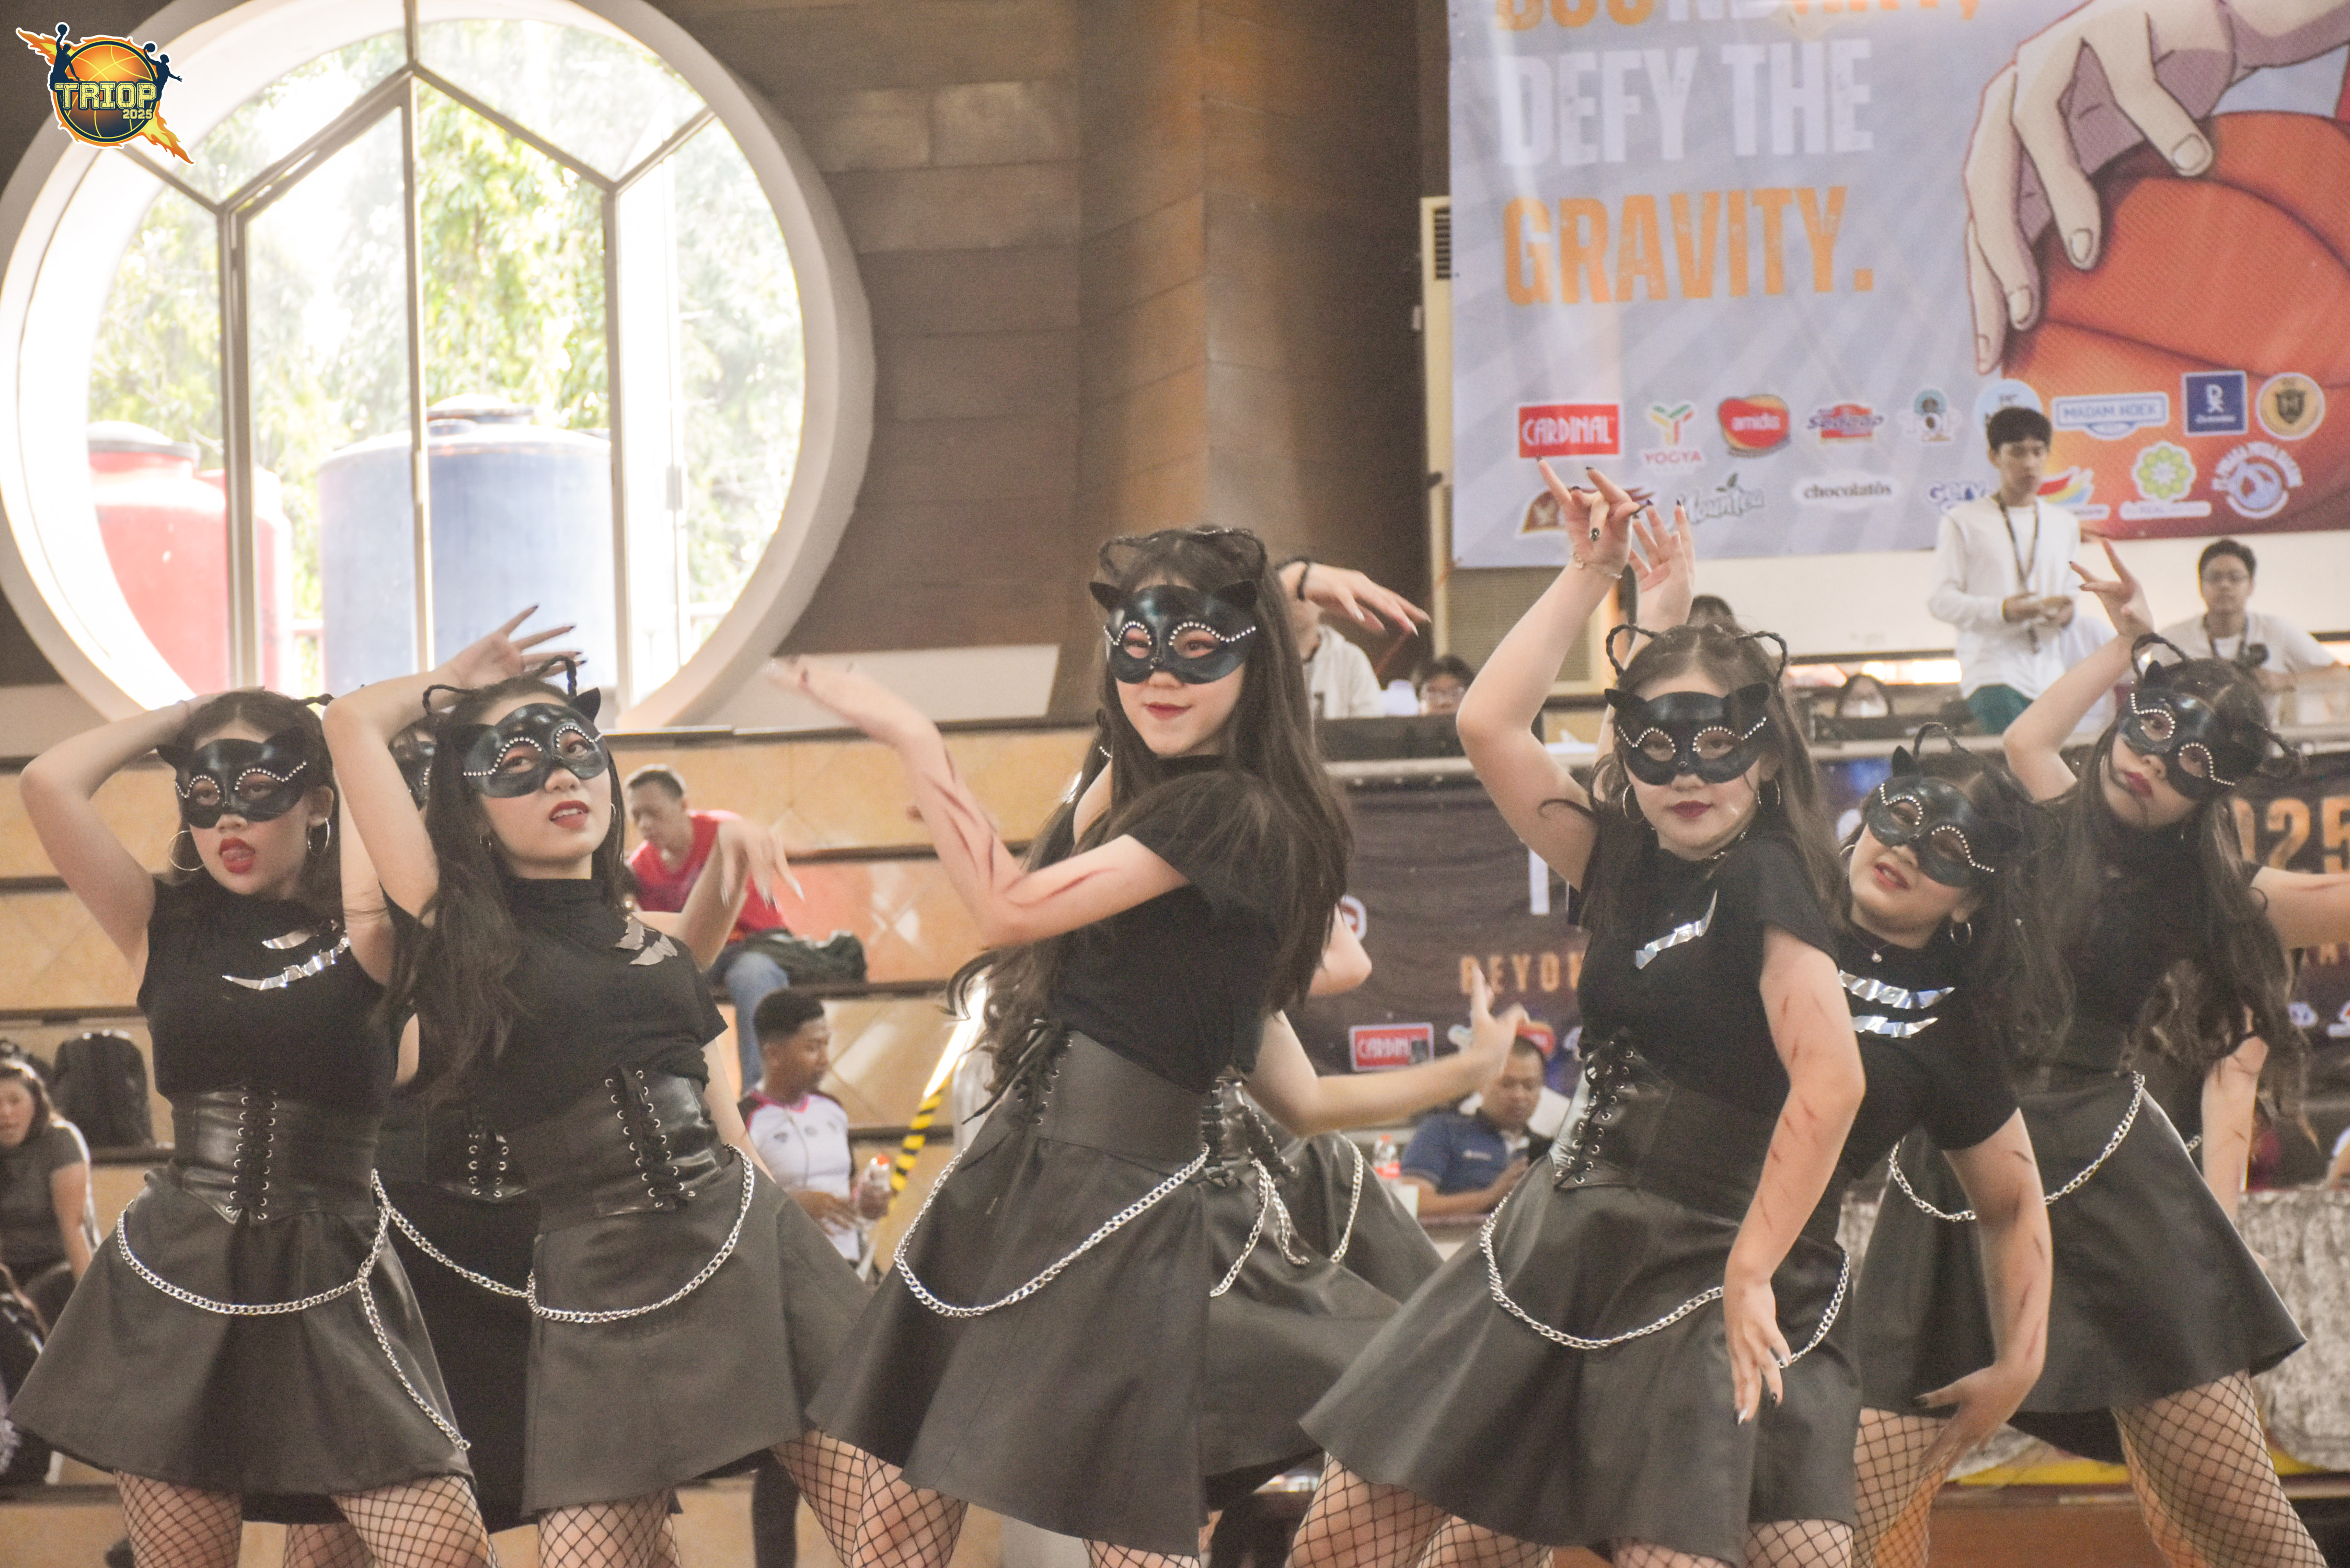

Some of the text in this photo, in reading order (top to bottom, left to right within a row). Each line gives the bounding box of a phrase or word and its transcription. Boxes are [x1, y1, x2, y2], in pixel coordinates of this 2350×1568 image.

[1499, 38, 1873, 167] DEFY THE
[1503, 186, 1873, 306] GRAVITY.
[1522, 417, 1612, 446] CARDINAL
[1644, 451, 1702, 464] YOGYA
